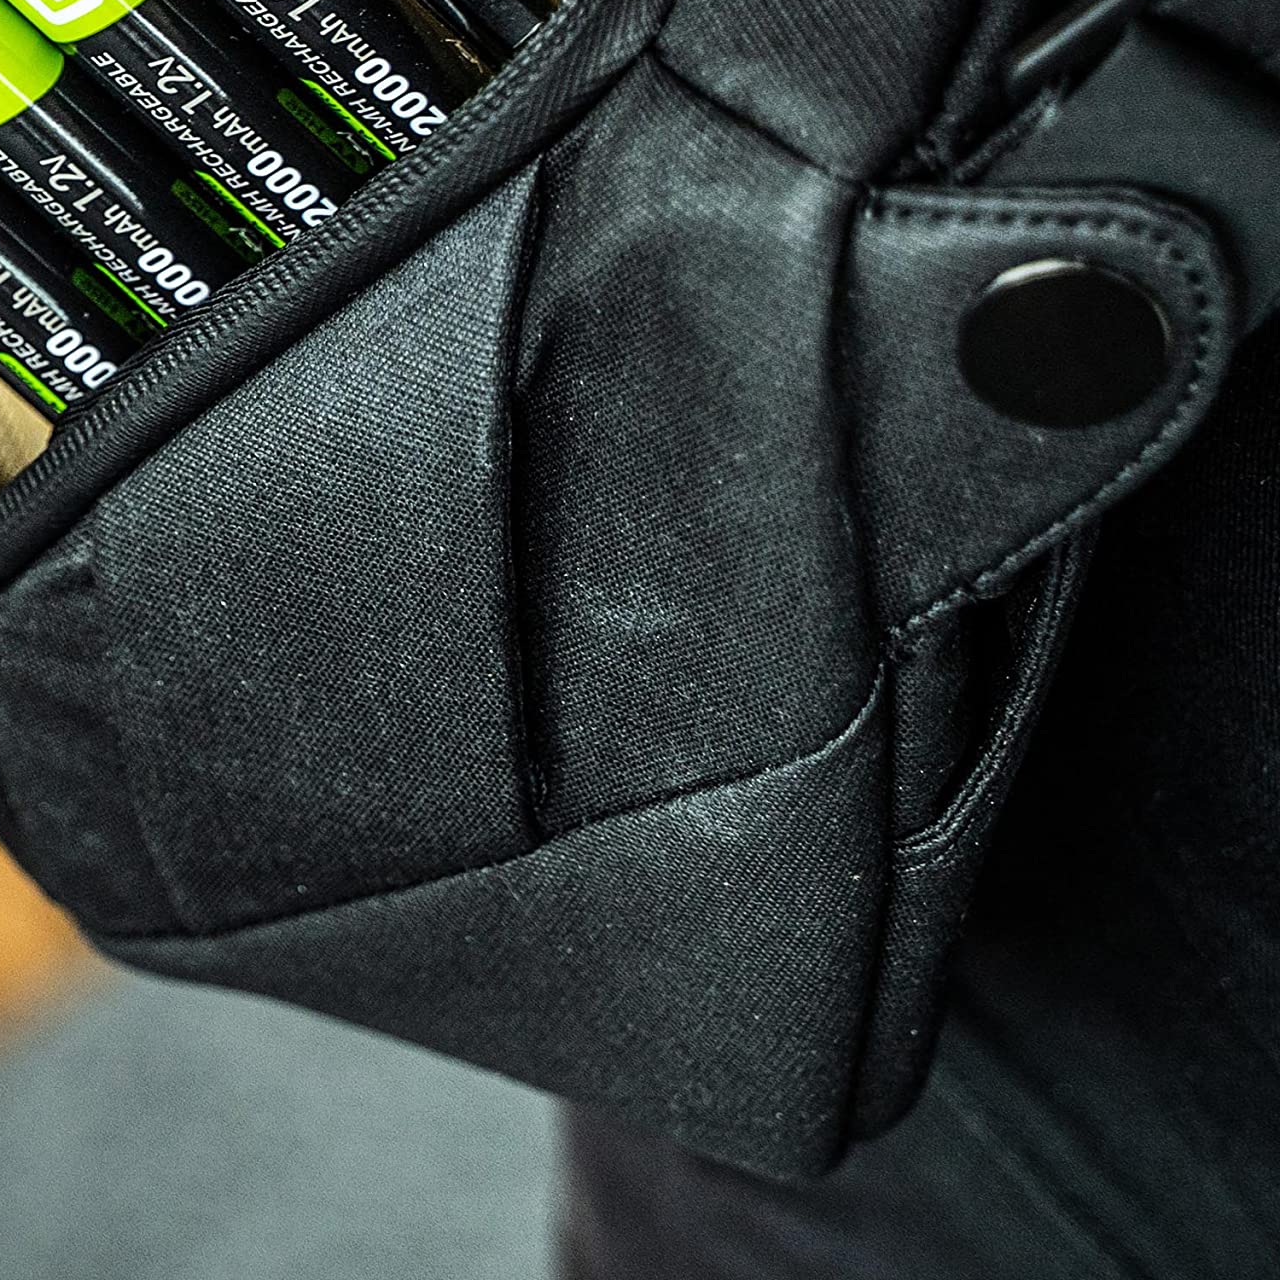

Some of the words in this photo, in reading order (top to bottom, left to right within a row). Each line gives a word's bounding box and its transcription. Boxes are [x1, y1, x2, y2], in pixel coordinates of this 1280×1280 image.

[91, 52, 249, 189] RECHARGEABLE
[320, 13, 448, 135] 2000mAh
[349, 98, 416, 152] Ni-MH
[213, 106, 338, 227] 2000mAh
[104, 204, 210, 313] 000mAh
[134, 285, 177, 319] -MH
[13, 283, 119, 389] 000mAh
